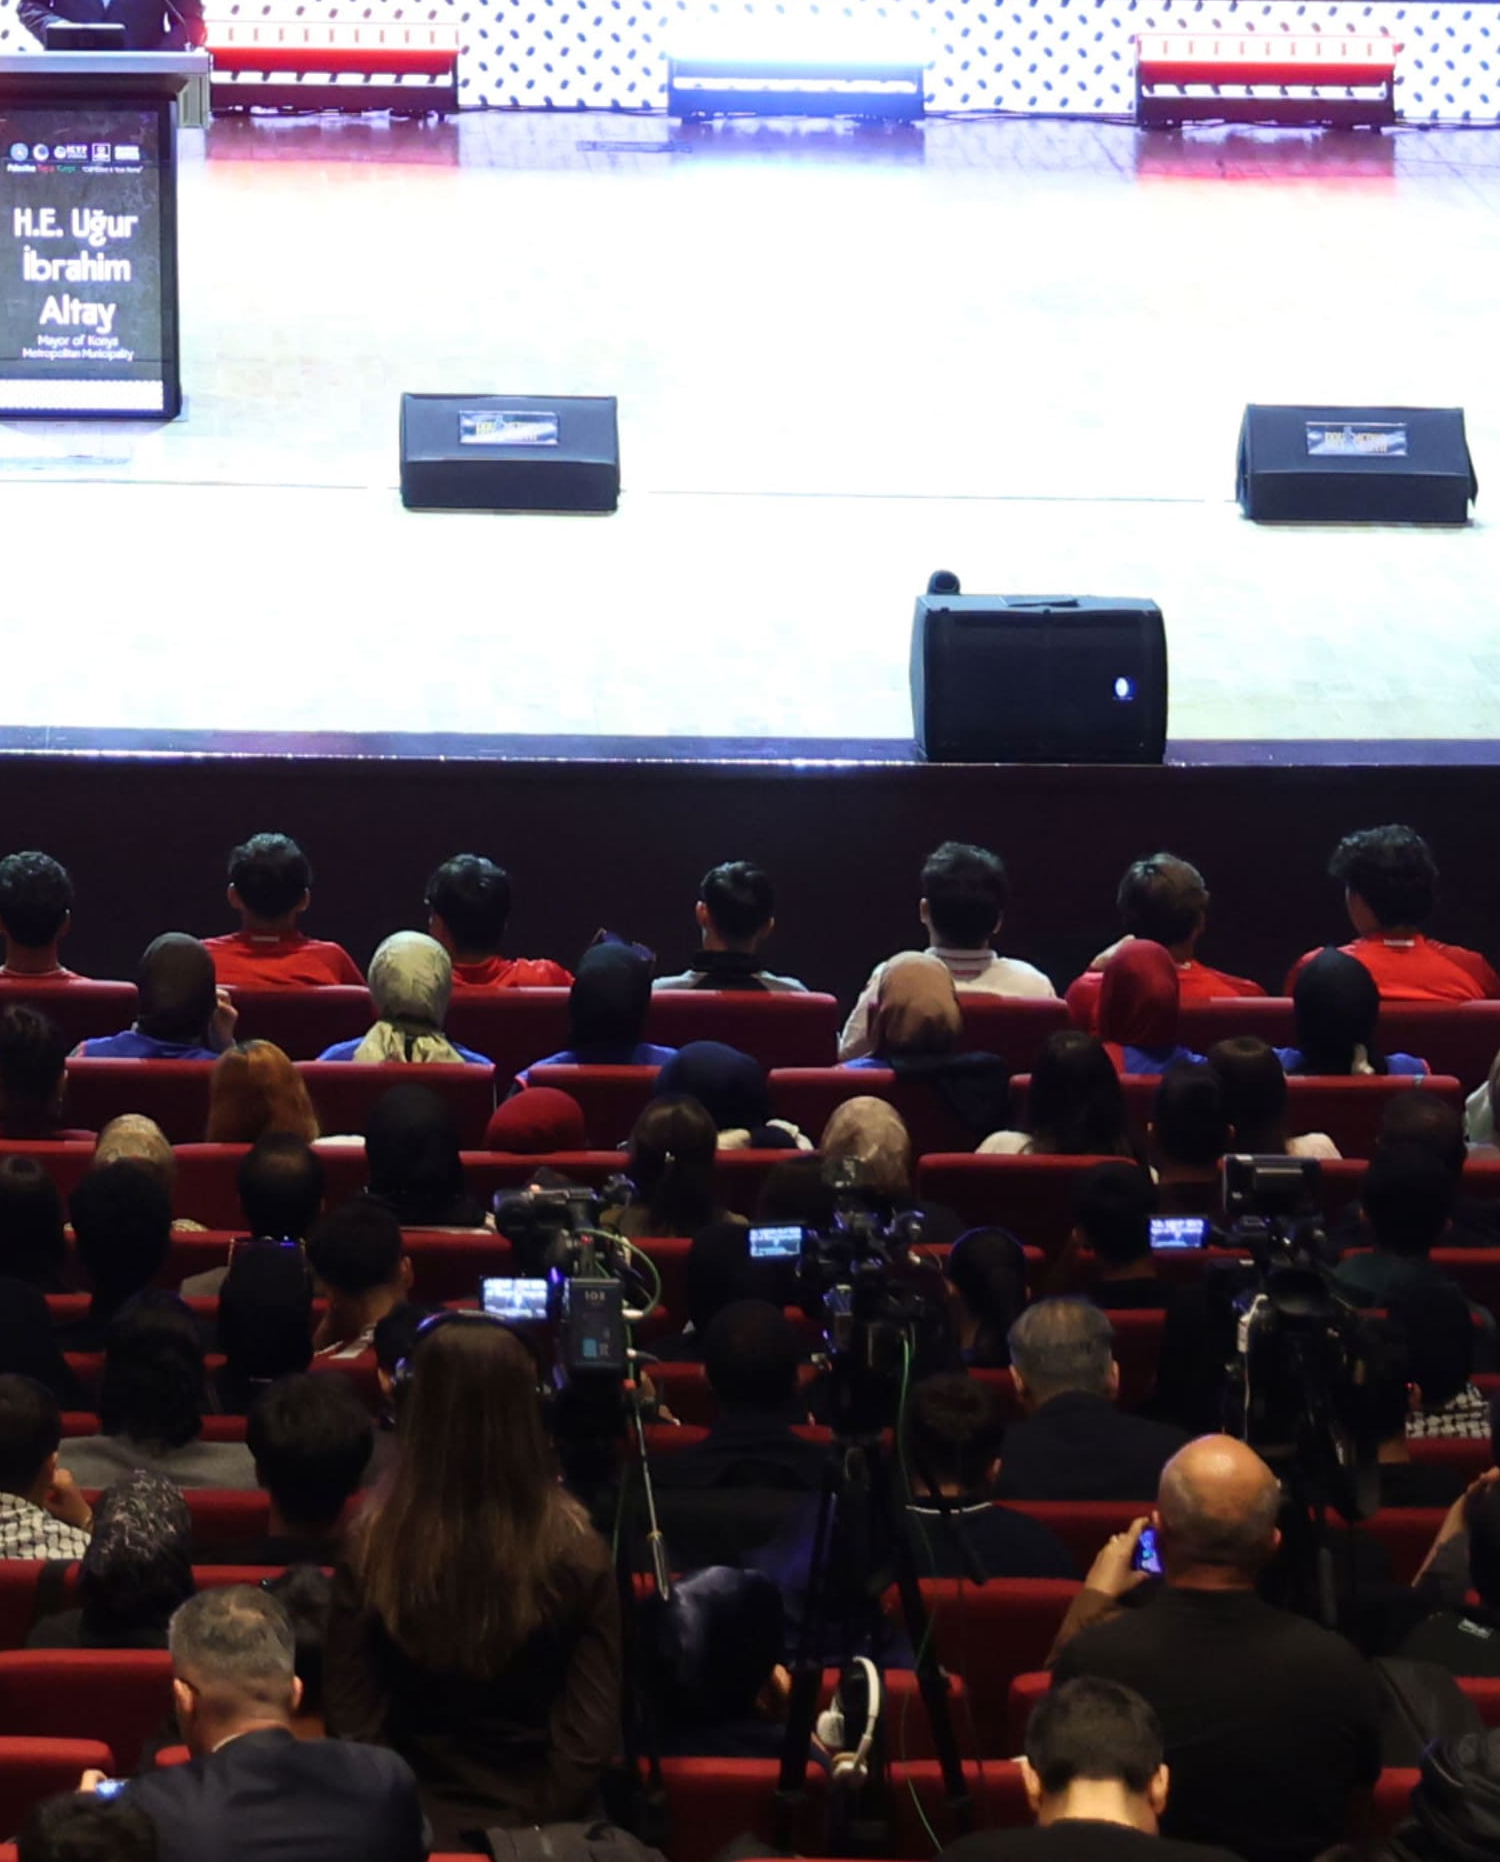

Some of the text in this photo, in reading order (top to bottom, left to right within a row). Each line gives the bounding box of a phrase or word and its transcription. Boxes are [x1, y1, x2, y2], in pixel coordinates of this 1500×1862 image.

[13, 208, 139, 247] H.E. Uğur
[23, 244, 132, 283] İbrahim
[38, 293, 117, 334] Altay
[21, 347, 135, 362] Metropolitan Municipality
[37, 334, 70, 349] Mayor
[72, 334, 86, 347] of
